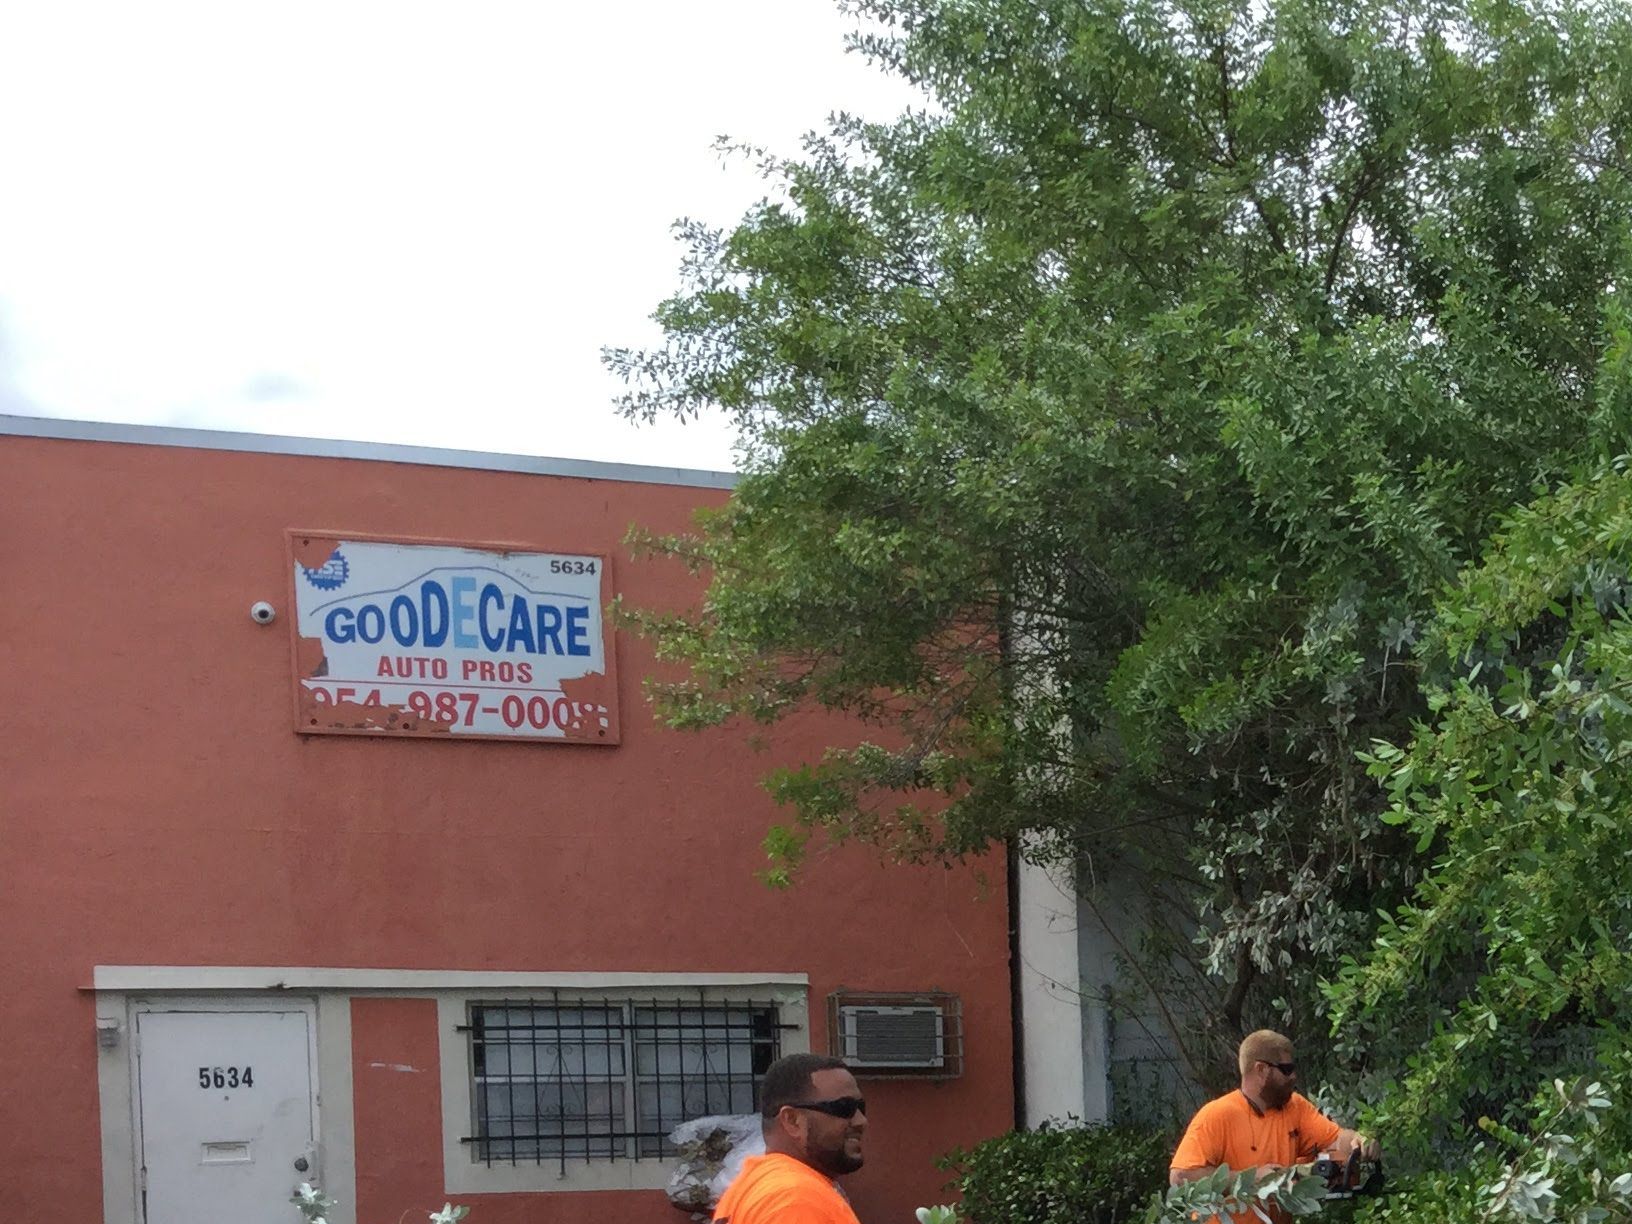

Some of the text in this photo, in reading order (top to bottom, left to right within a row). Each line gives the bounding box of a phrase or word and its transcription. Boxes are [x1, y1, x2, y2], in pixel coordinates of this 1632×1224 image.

[550, 559, 597, 576] 5634
[377, 655, 534, 684] AUTO PROS
[199, 1066, 254, 1090] 5634
